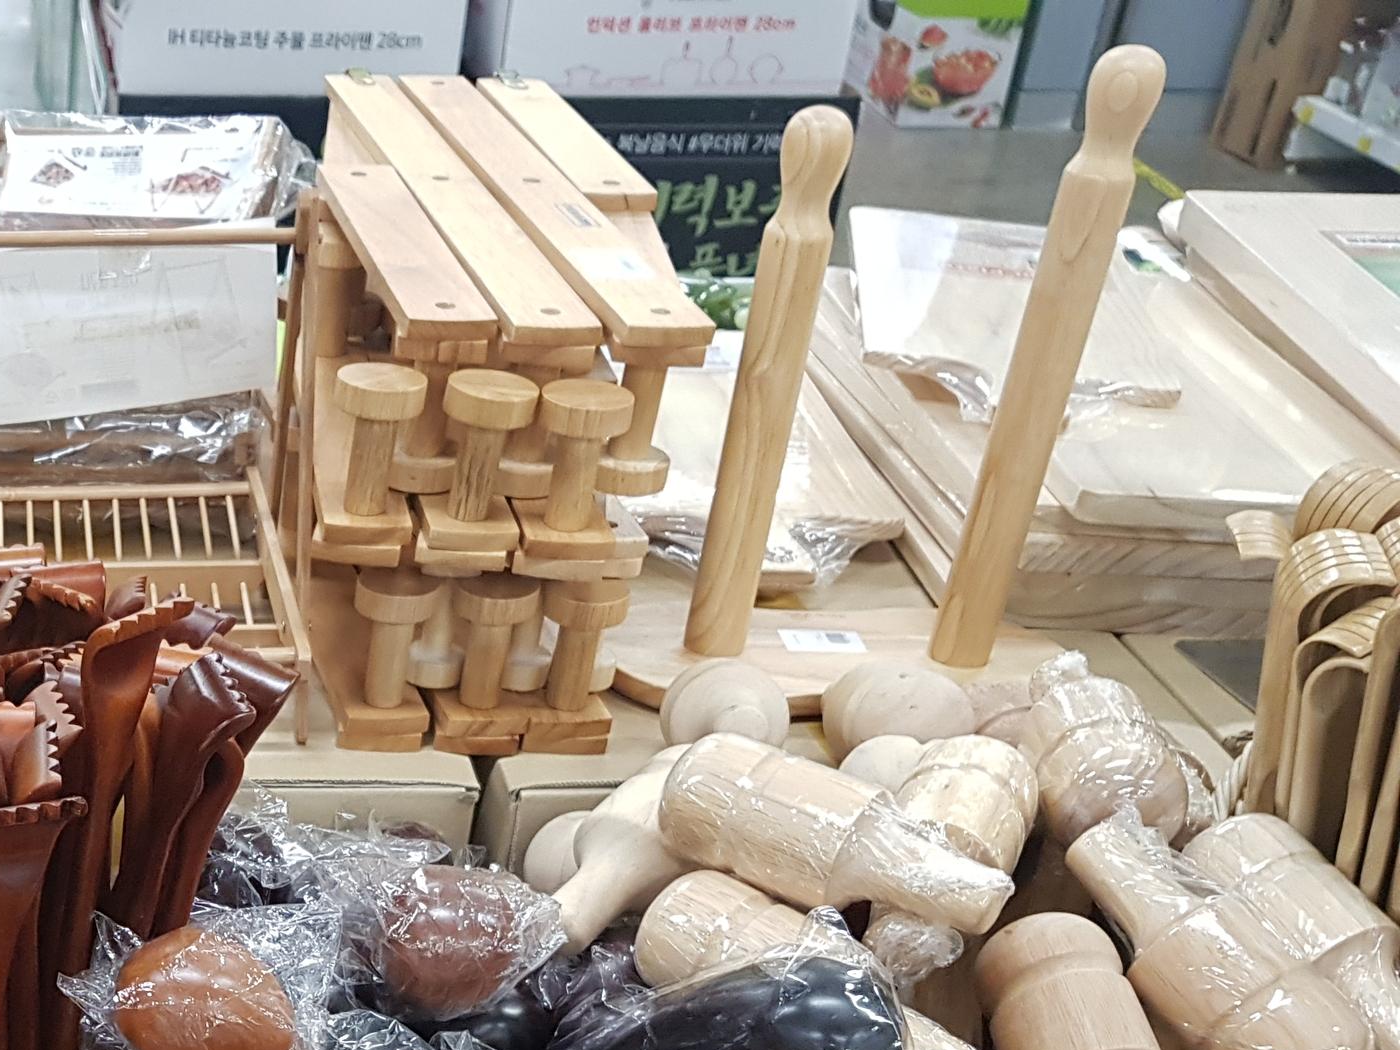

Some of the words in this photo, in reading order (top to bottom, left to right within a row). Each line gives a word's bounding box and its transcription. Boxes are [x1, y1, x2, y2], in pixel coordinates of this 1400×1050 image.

[753, 15, 796, 32] 28cm
[189, 28, 269, 49] 티타늄코팅
[309, 31, 373, 50] 프라이팬
[376, 31, 424, 50] 28cm
